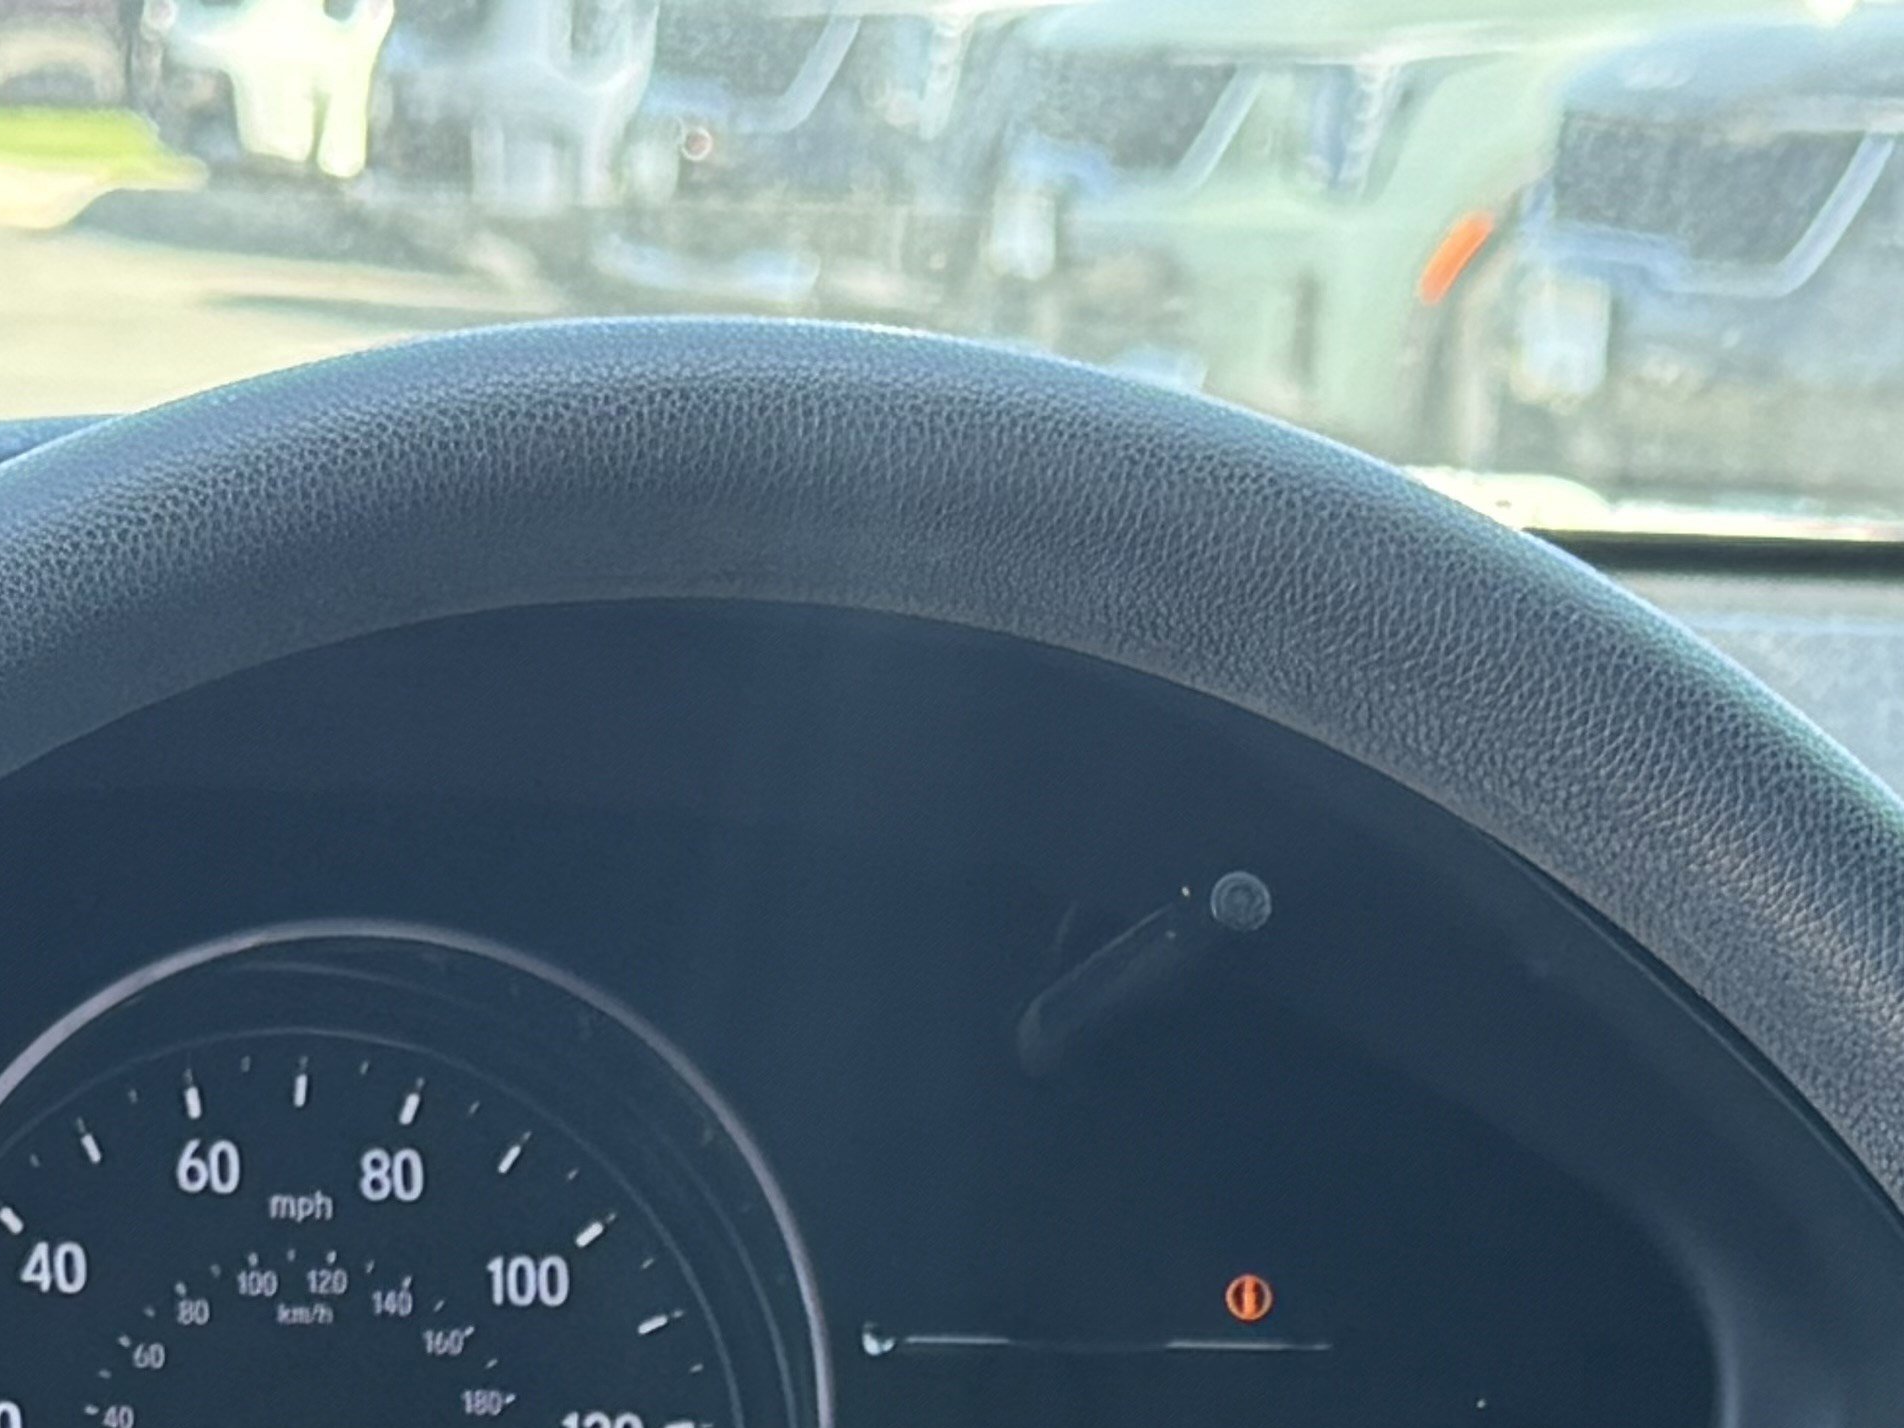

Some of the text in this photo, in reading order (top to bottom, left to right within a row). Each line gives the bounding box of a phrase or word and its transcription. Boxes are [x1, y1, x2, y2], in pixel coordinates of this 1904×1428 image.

[177, 1140, 240, 1193] 60
[361, 1149, 424, 1201] 80
[269, 1191, 333, 1223] mph
[22, 1243, 86, 1295] 40
[237, 1269, 278, 1297] 100
[307, 1267, 347, 1296] 120
[488, 1255, 568, 1306] 100
[177, 1298, 209, 1325] 80
[277, 1300, 333, 1325] km/h
[372, 1288, 412, 1317] 140
[423, 1327, 465, 1355] 160
[133, 1342, 165, 1371] 60
[462, 1389, 503, 1416] 180
